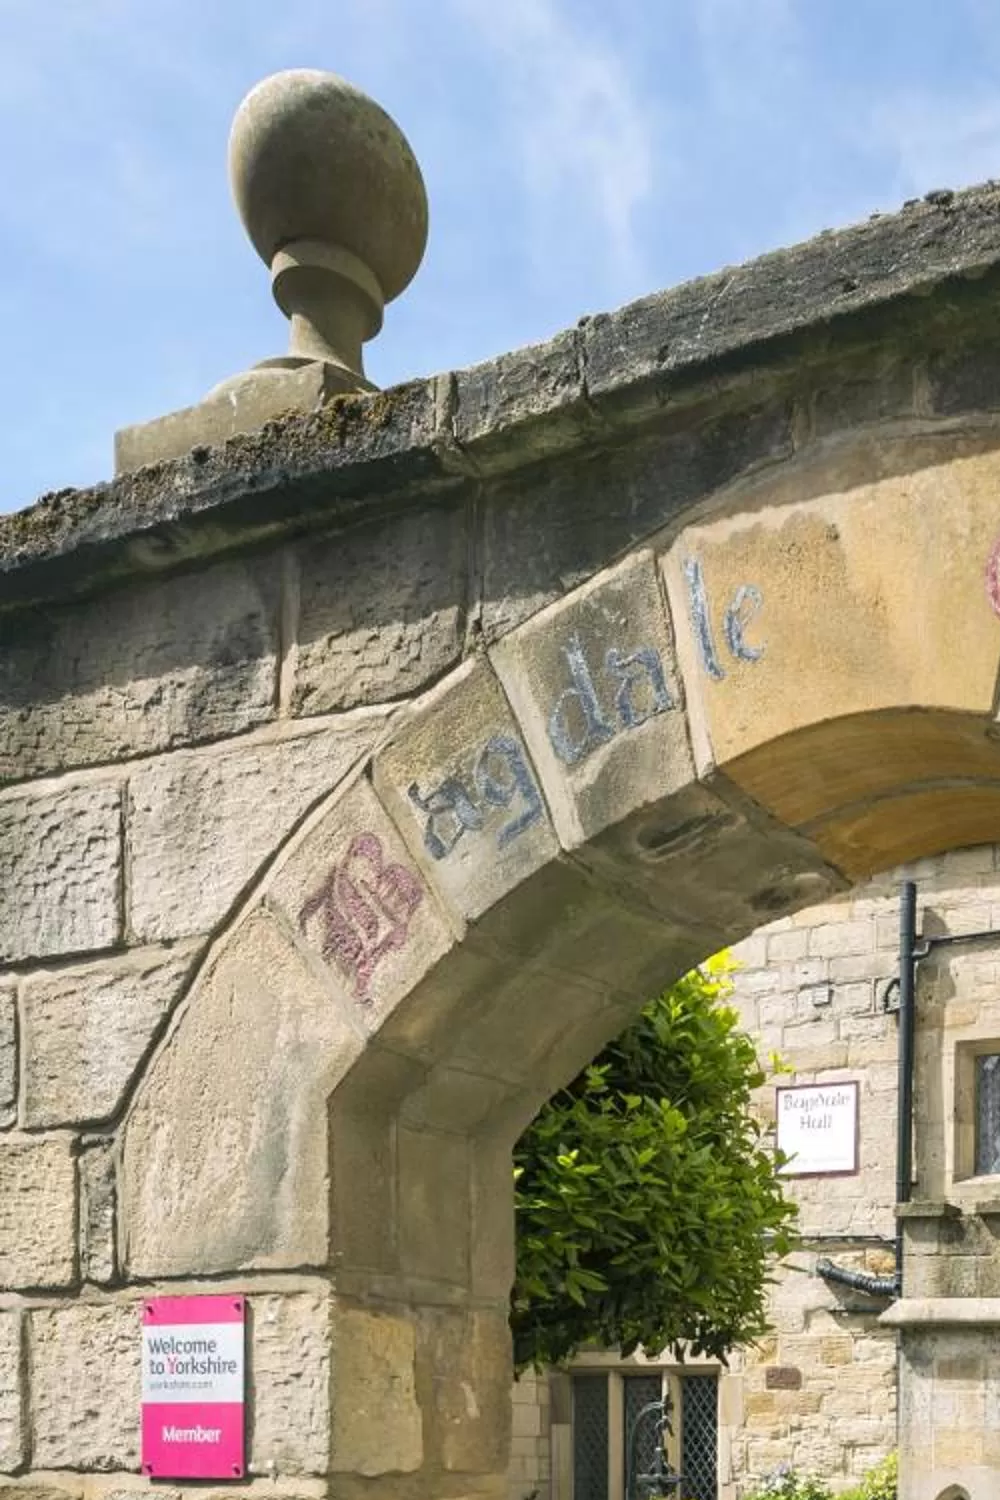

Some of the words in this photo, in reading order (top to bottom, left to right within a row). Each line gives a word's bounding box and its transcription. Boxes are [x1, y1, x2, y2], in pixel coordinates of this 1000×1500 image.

[303, 553, 769, 1004] Bagdale
[149, 1335, 217, 1355] Welcome
[150, 1358, 165, 1375] to
[167, 1355, 237, 1376] Yorkshire
[162, 1424, 222, 1443] Member
